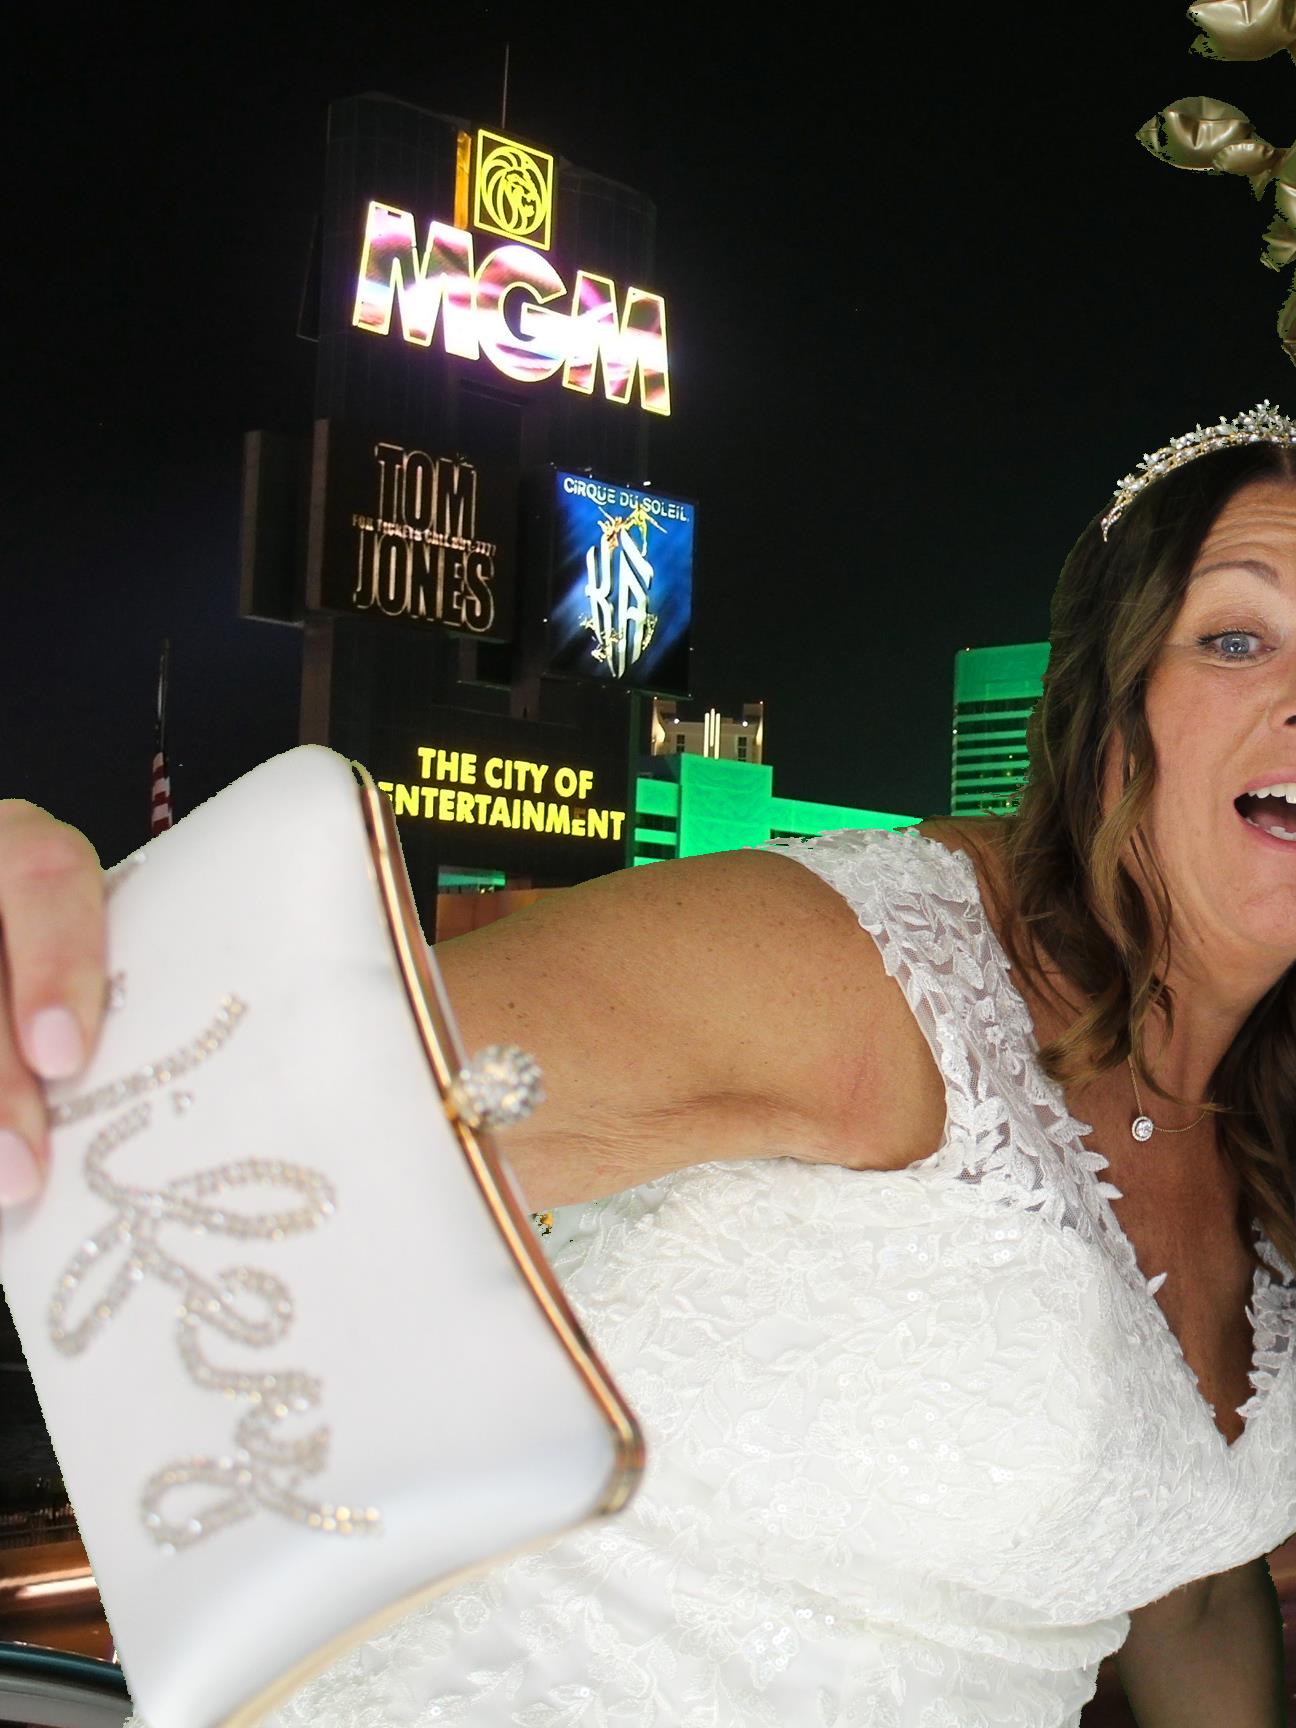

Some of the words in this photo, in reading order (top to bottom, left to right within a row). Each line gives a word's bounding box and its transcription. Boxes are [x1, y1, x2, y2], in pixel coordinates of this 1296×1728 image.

[353, 201, 671, 416] MGM
[374, 442, 476, 540] TOM
[564, 477, 616, 506] CIRQUE
[620, 491, 639, 509] DU
[642, 497, 688, 522] SOLEIL
[353, 530, 495, 632] JONES
[418, 746, 477, 785] THE
[484, 757, 549, 794] CITY
[554, 767, 594, 800] OF
